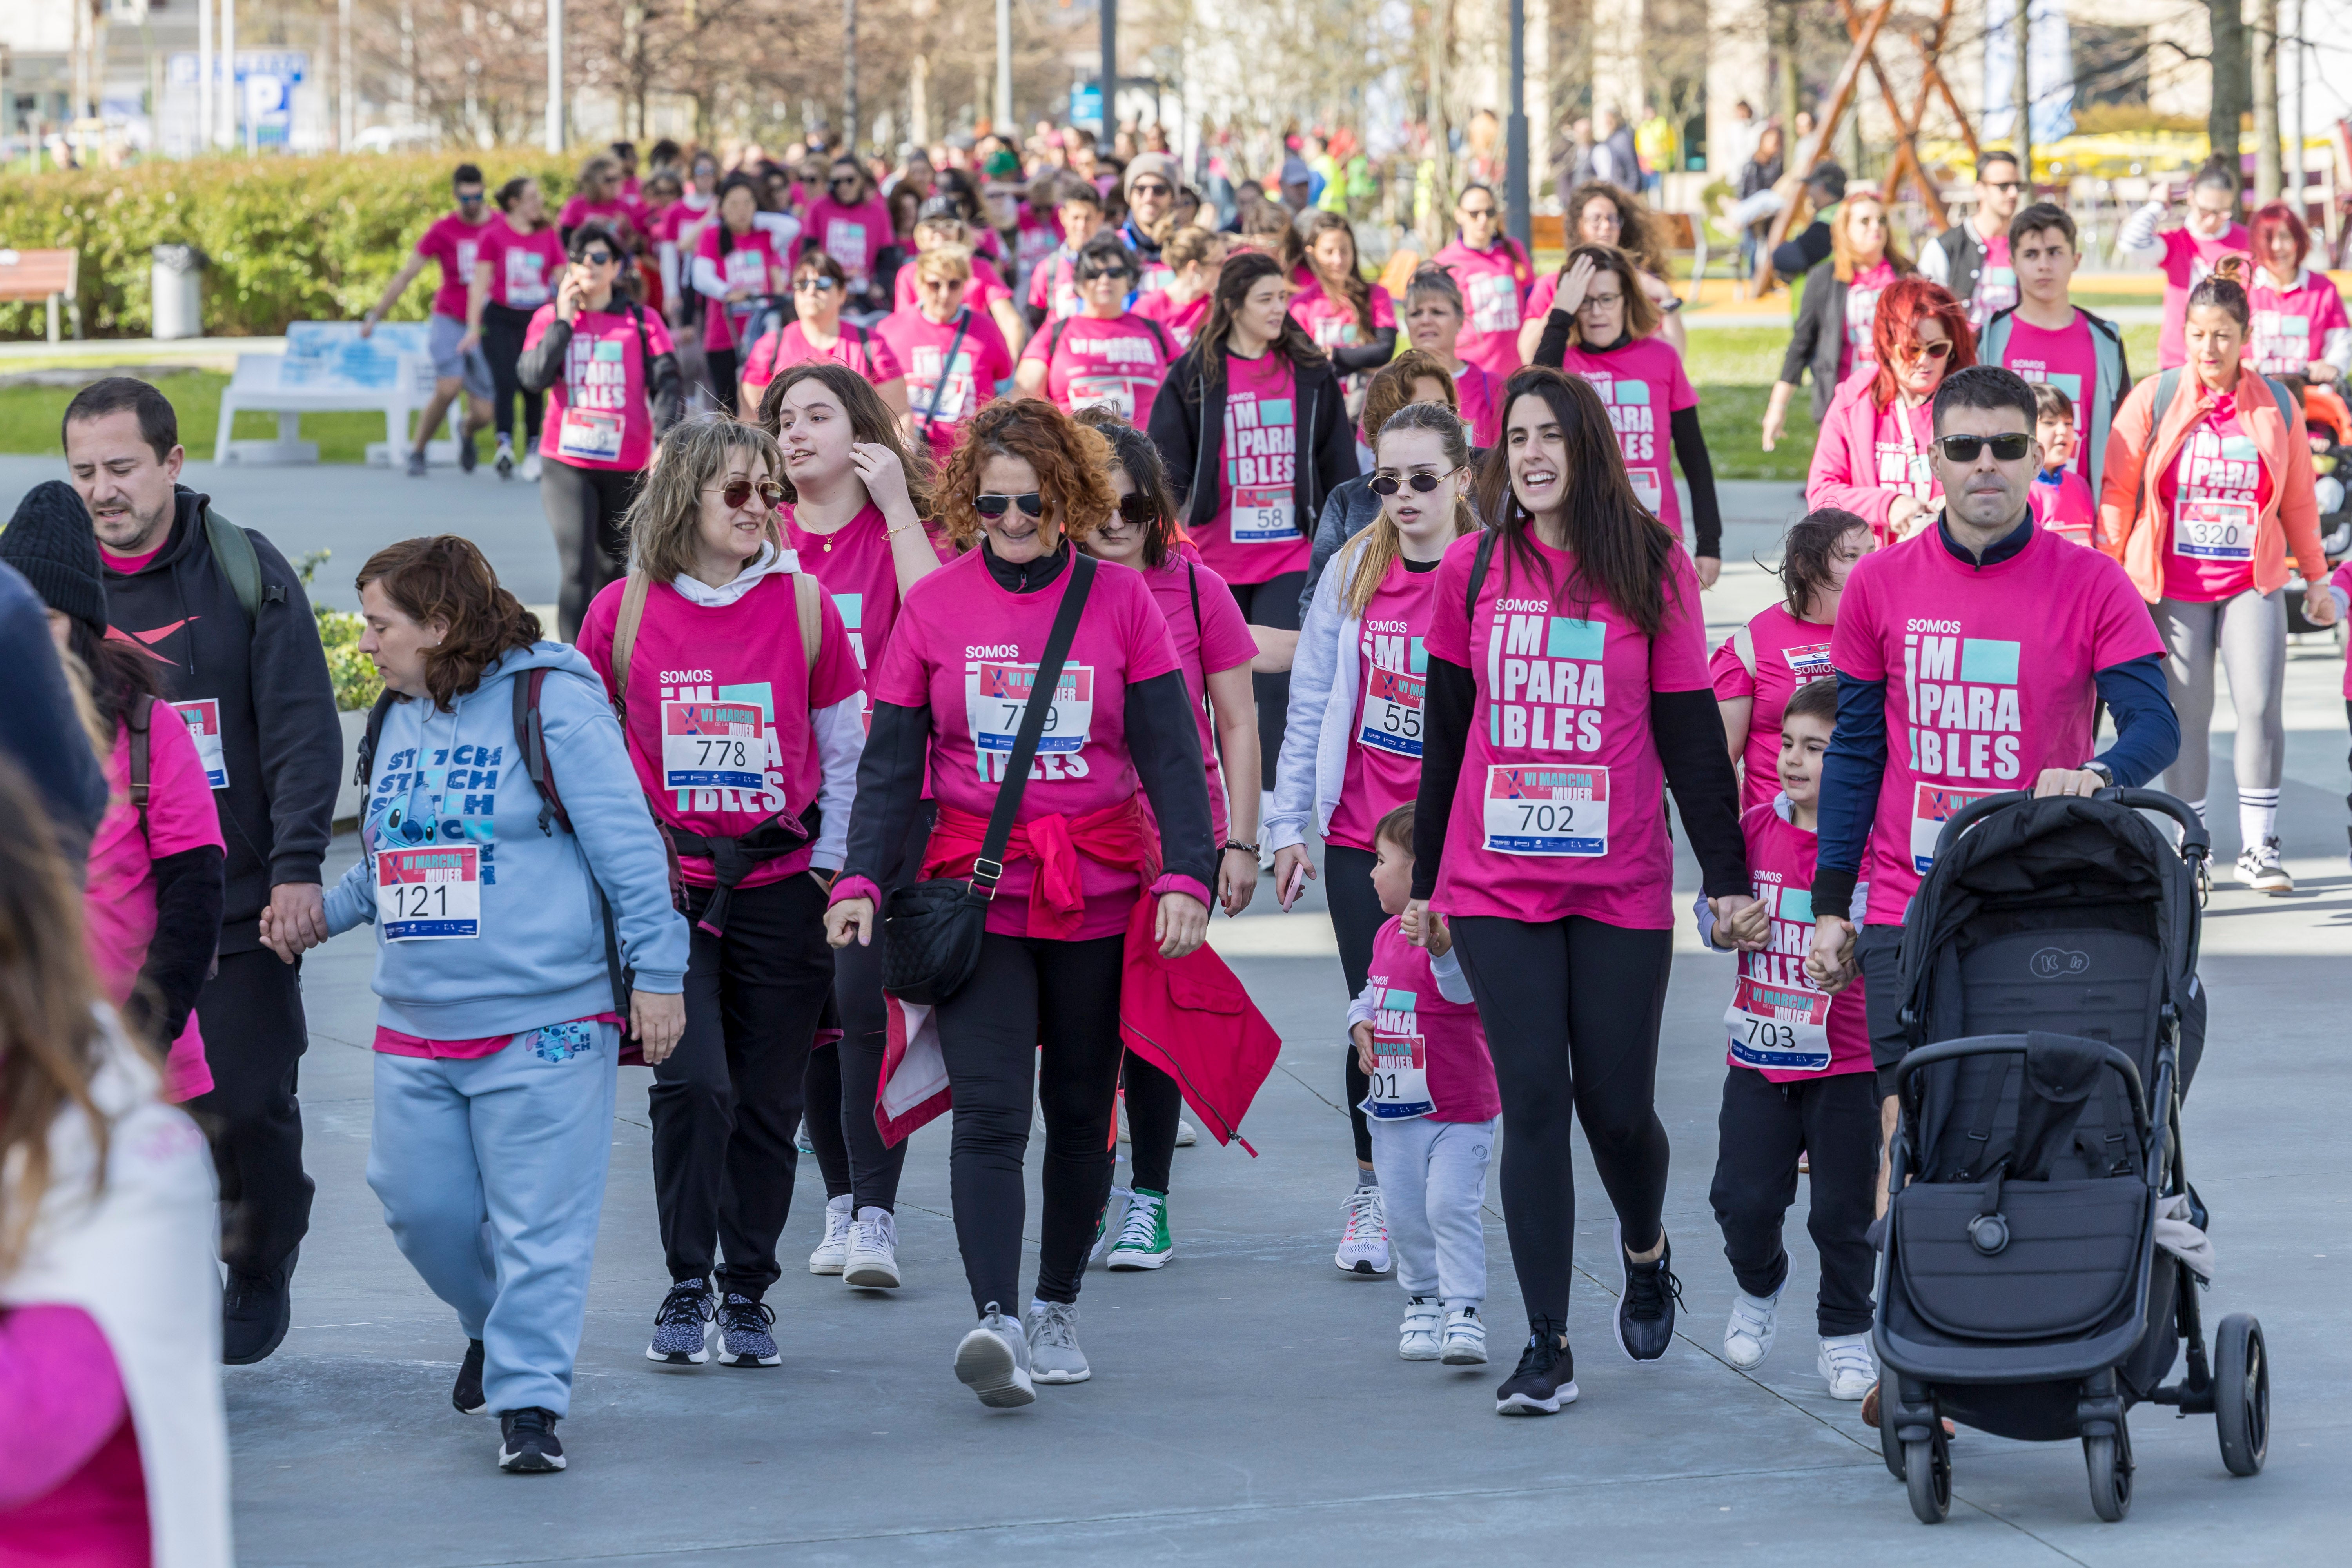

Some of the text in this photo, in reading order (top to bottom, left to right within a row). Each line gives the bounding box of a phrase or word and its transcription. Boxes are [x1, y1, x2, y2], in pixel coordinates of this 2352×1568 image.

[1227, 392, 1256, 403] OMOS
[1608, 406, 1654, 433] ARA
[1237, 426, 1296, 457] PARA
[1228, 454, 1296, 485] IBLES
[2193, 458, 2259, 490] PARA
[1258, 508, 1283, 528] 58
[2194, 524, 2238, 545] 320
[1495, 599, 1548, 612] SOMOS
[1367, 620, 1407, 633] OMOS
[1906, 618, 1961, 634] SOMOS
[965, 644, 1019, 658] SOMOS
[660, 669, 713, 684] SOMOS
[1008, 672, 1021, 686] VI
[1398, 680, 1408, 693] VI
[1504, 659, 1605, 707] PARA
[701, 708, 755, 724] VI MARCHA
[1919, 683, 2022, 732] PARA
[1002, 704, 1058, 732] 79
[1490, 704, 1602, 752] IBLES
[729, 722, 754, 738] MUJER
[387, 745, 503, 771] STITCH
[696, 740, 746, 767] 778
[1909, 728, 2020, 780] IBLES
[1524, 772, 1593, 788] VI MARCHA
[1552, 787, 1593, 801] MUJER
[1949, 795, 1963, 809] VI
[1518, 805, 1574, 832] 702
[403, 854, 463, 870] VI MARCHA
[425, 868, 463, 882] MUJER
[1753, 869, 1782, 883] SOMOS
[395, 885, 446, 918] 121
[1766, 921, 1815, 956] ARA
[1753, 987, 1814, 1011] VI MARCHA
[1774, 1005, 1811, 1025] MUJER
[1746, 1018, 1796, 1049] 703
[1378, 1056, 1414, 1069] MUJER
